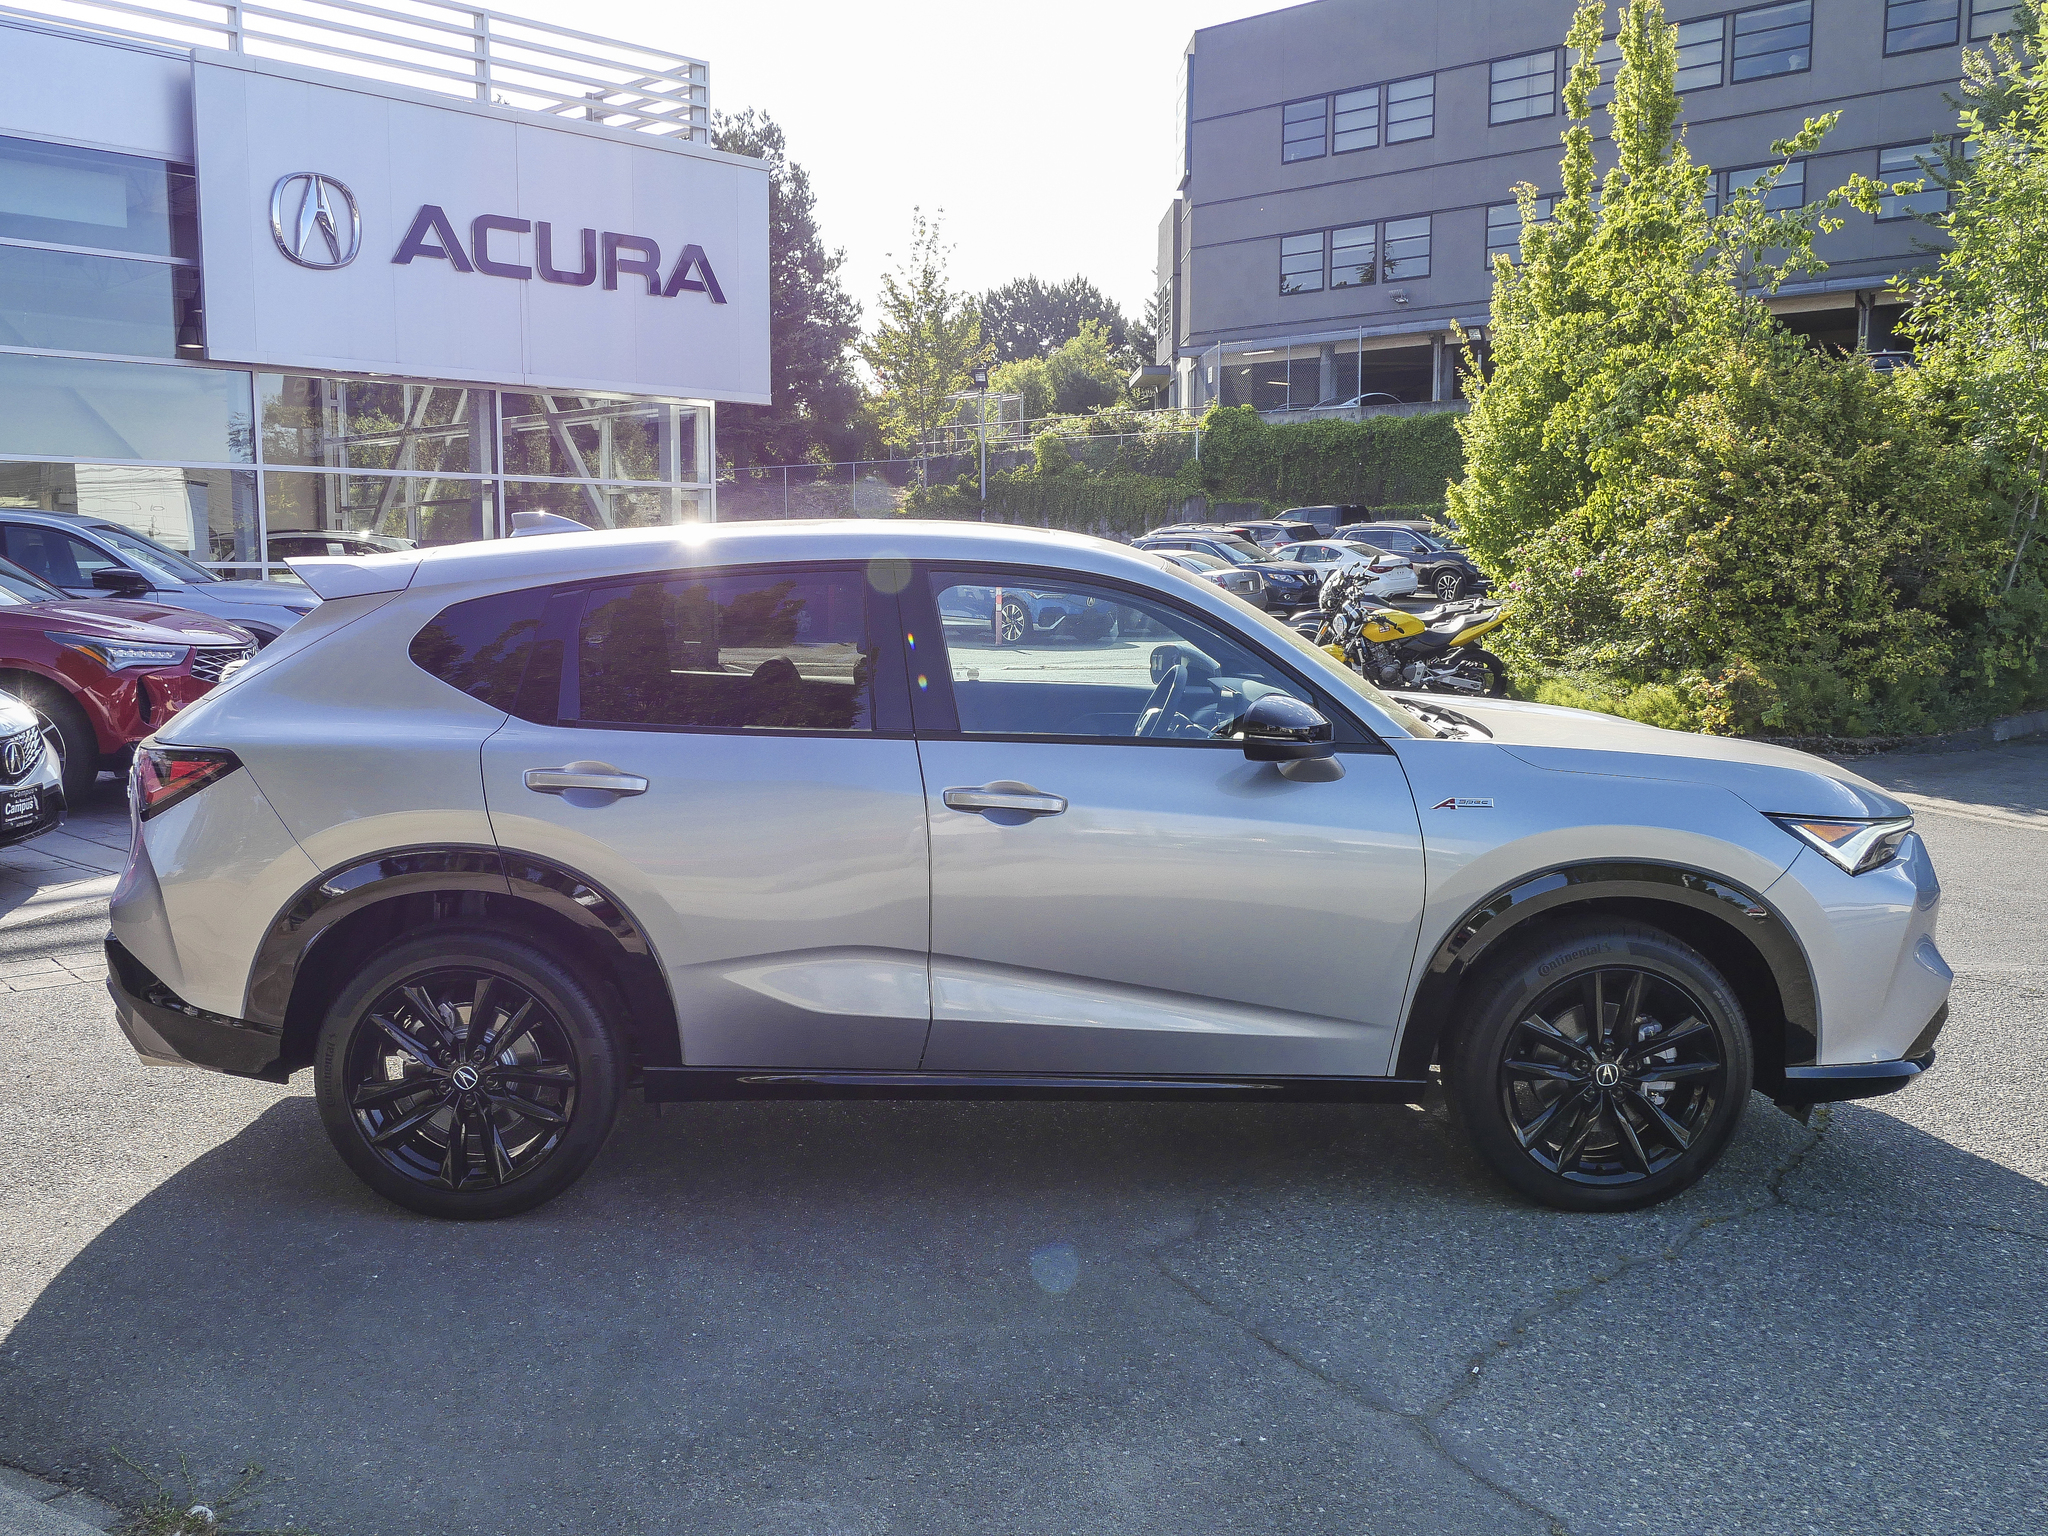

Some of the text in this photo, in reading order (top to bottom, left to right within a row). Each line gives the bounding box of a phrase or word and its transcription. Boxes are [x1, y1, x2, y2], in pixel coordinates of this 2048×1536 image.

[391, 203, 728, 305] ACURA
[5, 801, 34, 815] Campus
[1537, 942, 1602, 978] Continental
